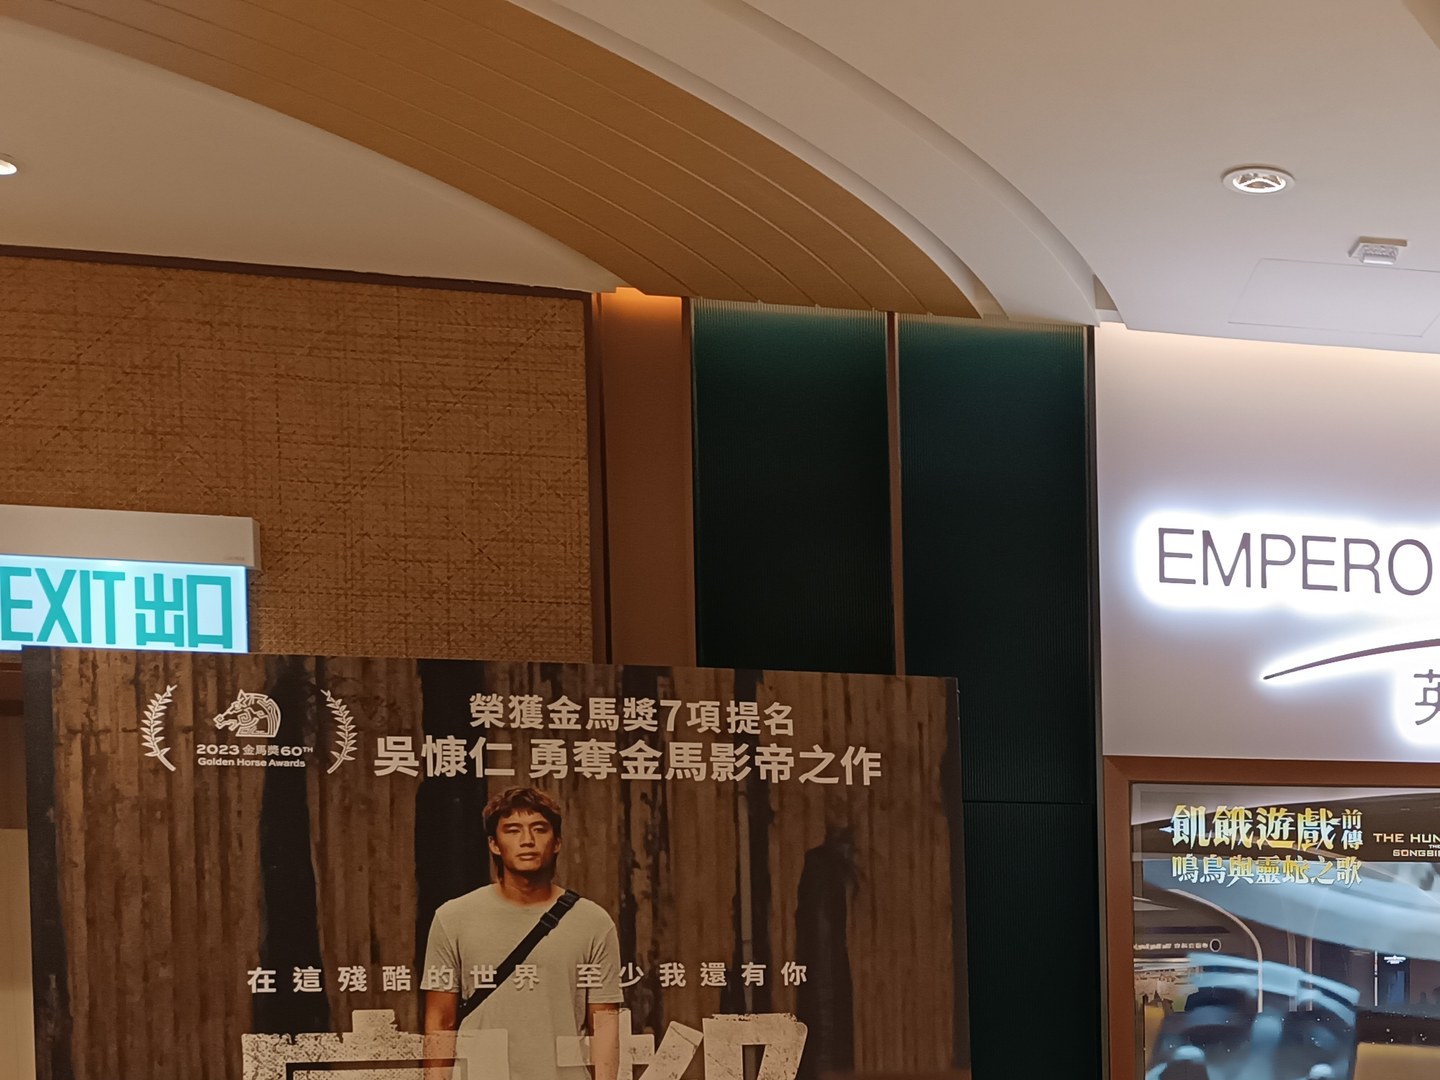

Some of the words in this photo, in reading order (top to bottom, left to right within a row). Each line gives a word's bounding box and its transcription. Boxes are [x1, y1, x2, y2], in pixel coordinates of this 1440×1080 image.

[0, 567, 126, 645] EXIT
[134, 573, 233, 649] 出口
[469, 693, 795, 737] 榮獲金馬獎7項提名
[196, 744, 240, 756] 2023
[198, 757, 235, 767] Golden
[237, 758, 267, 768] Horse
[268, 759, 306, 768] Awards
[373, 735, 516, 779] 吳慷仁
[529, 739, 884, 786] 勇奪金馬影帝之作
[1373, 833, 1405, 843] THE
[246, 964, 540, 995] 在這殘酷的世界
[576, 961, 808, 988] 至少我還有你
